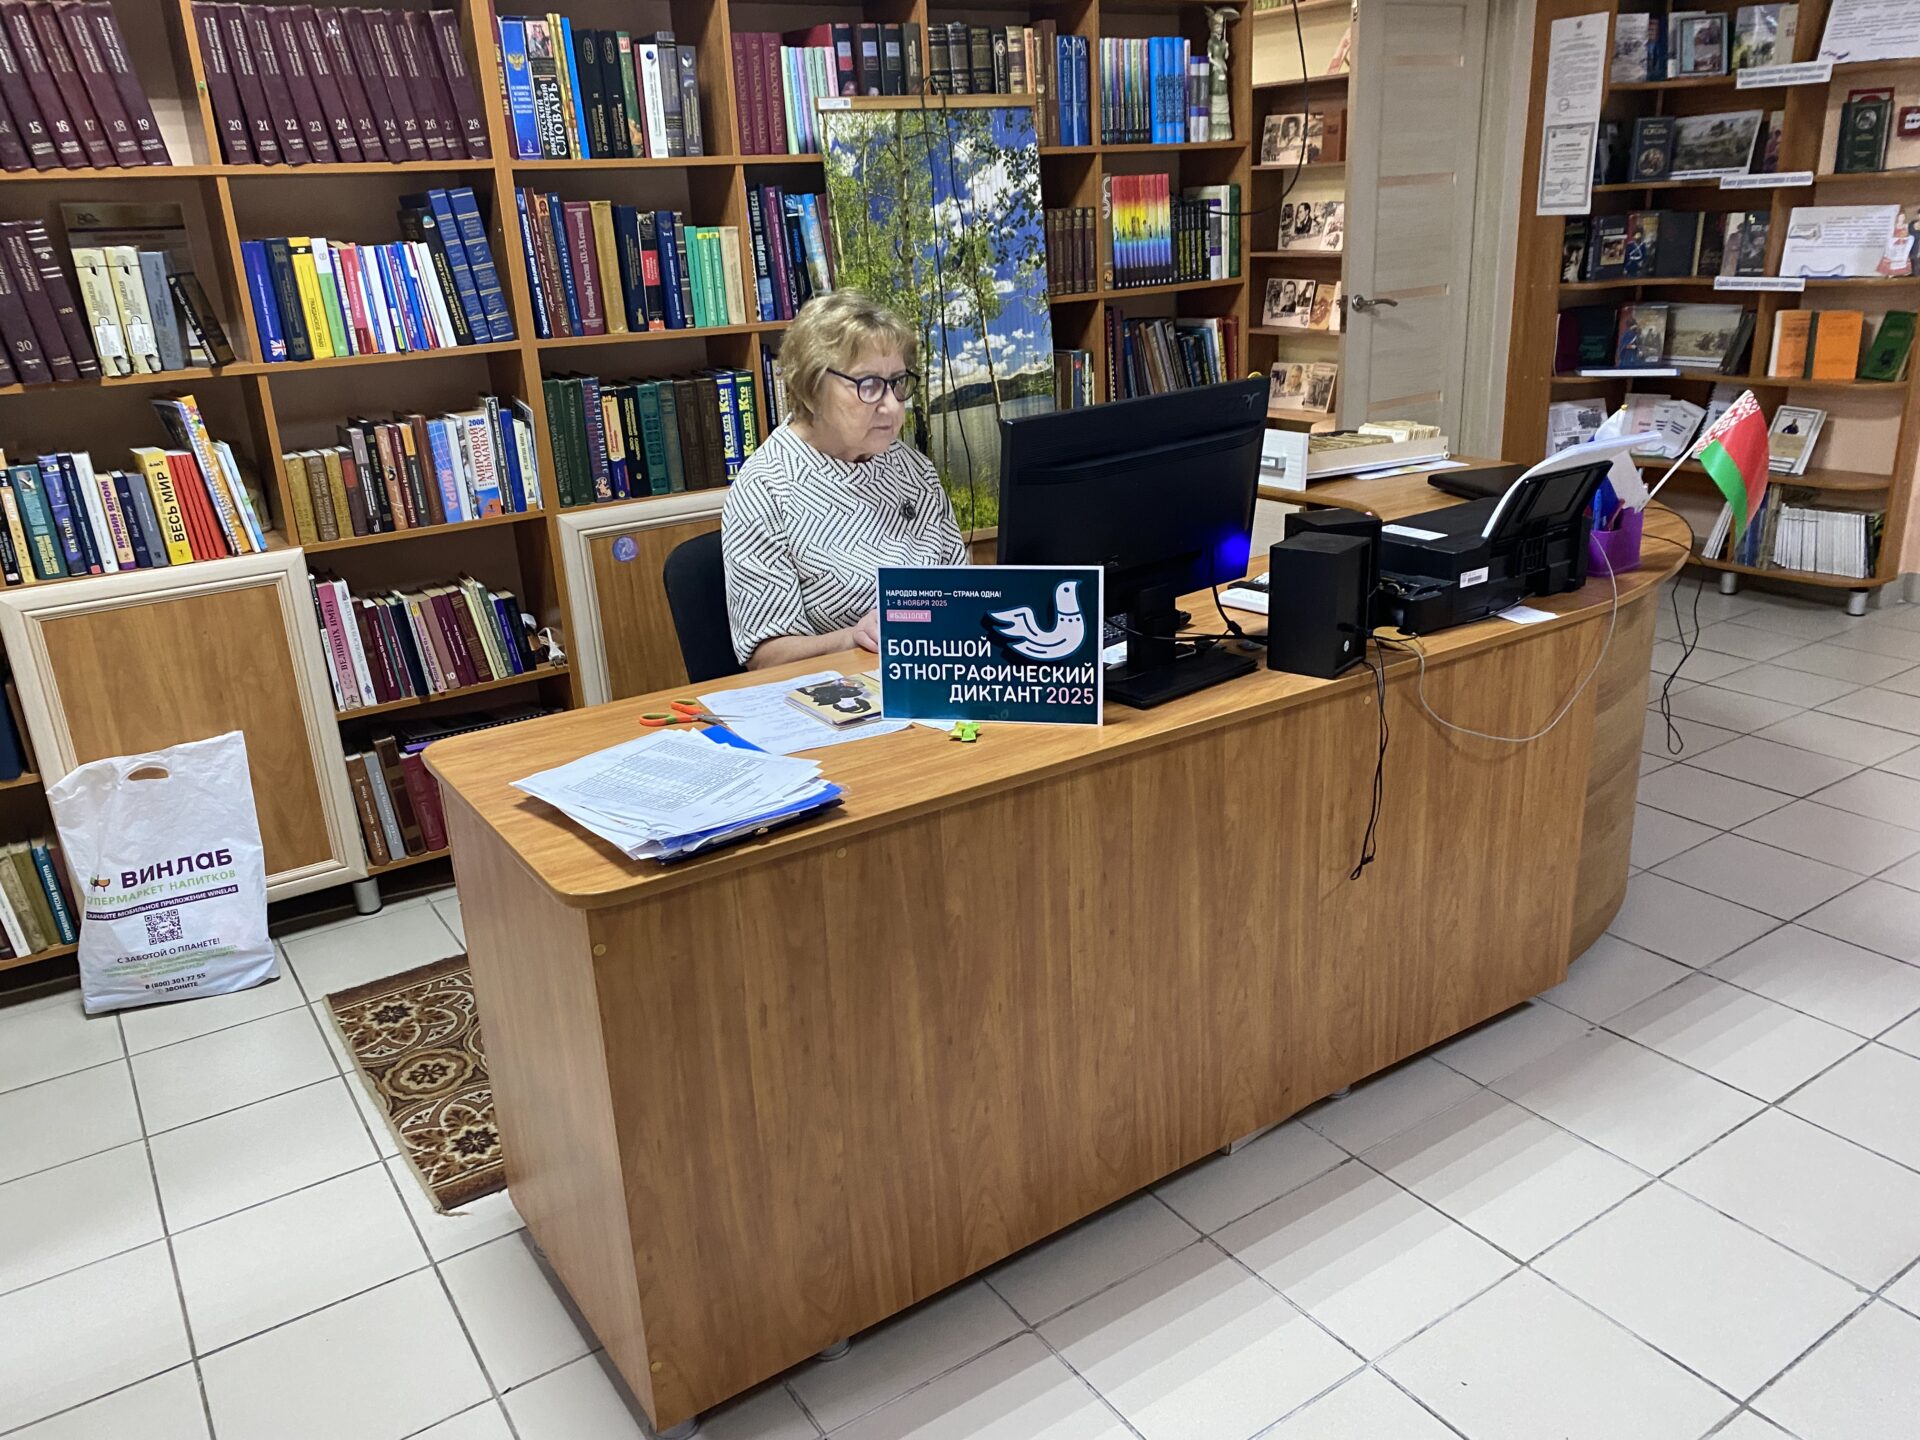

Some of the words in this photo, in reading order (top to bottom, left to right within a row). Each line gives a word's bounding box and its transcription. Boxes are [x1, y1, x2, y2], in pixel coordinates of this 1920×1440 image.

[137, 119, 150, 130] 19
[228, 119, 242, 131] 20
[257, 120, 270, 131] 21
[284, 119, 298, 130] 22
[309, 121, 322, 132] 23
[425, 119, 437, 130] 26
[468, 119, 481, 130] 28
[537, 99, 548, 141] РУССКИЙ
[548, 82, 567, 156] СЛОВАРЬ
[18, 340, 32, 352] 30
[468, 418, 485, 427] 2008
[468, 426, 486, 482] МИРОВОЙ
[480, 425, 494, 481] АЛЬМАНАХ
[101, 481, 114, 512] ЯЛОМ
[157, 471, 175, 503] МИР
[110, 513, 125, 549] ИРВИН
[167, 505, 186, 542] ВЕСЬ
[68, 538, 78, 553] ВЕК
[886, 589, 918, 598] НАРОДОВ
[919, 590, 943, 598] МНОГО
[953, 590, 980, 599] СТРАНА
[980, 590, 1002, 599] ОДНА!
[332, 628, 348, 671] ВЕЛИКИХ
[887, 636, 992, 658] БОЛЬШОЙ
[446, 672, 456, 681] 10
[888, 662, 1095, 684] ЭТНОГРАФИЧЕСКИЙ
[949, 684, 1043, 704] ДИКТАНТ
[1046, 687, 1095, 704] 2025
[121, 848, 233, 889] ВИНЛАБ
[169, 869, 236, 891] НАПИТКОВ
[117, 903, 160, 917] МОБИЛЬНОЕ
[160, 892, 206, 907] ПРИЛОЖЕНИЕ
[207, 886, 237, 897] WINELAB
[124, 950, 168, 962] ЗАБОТОЙ
[177, 938, 221, 952] ПЛАНЕТЕ!
[151, 981, 171, 989] (800)
[172, 977, 186, 985] 301
[165, 982, 199, 993] ЗВОНИТЕ
